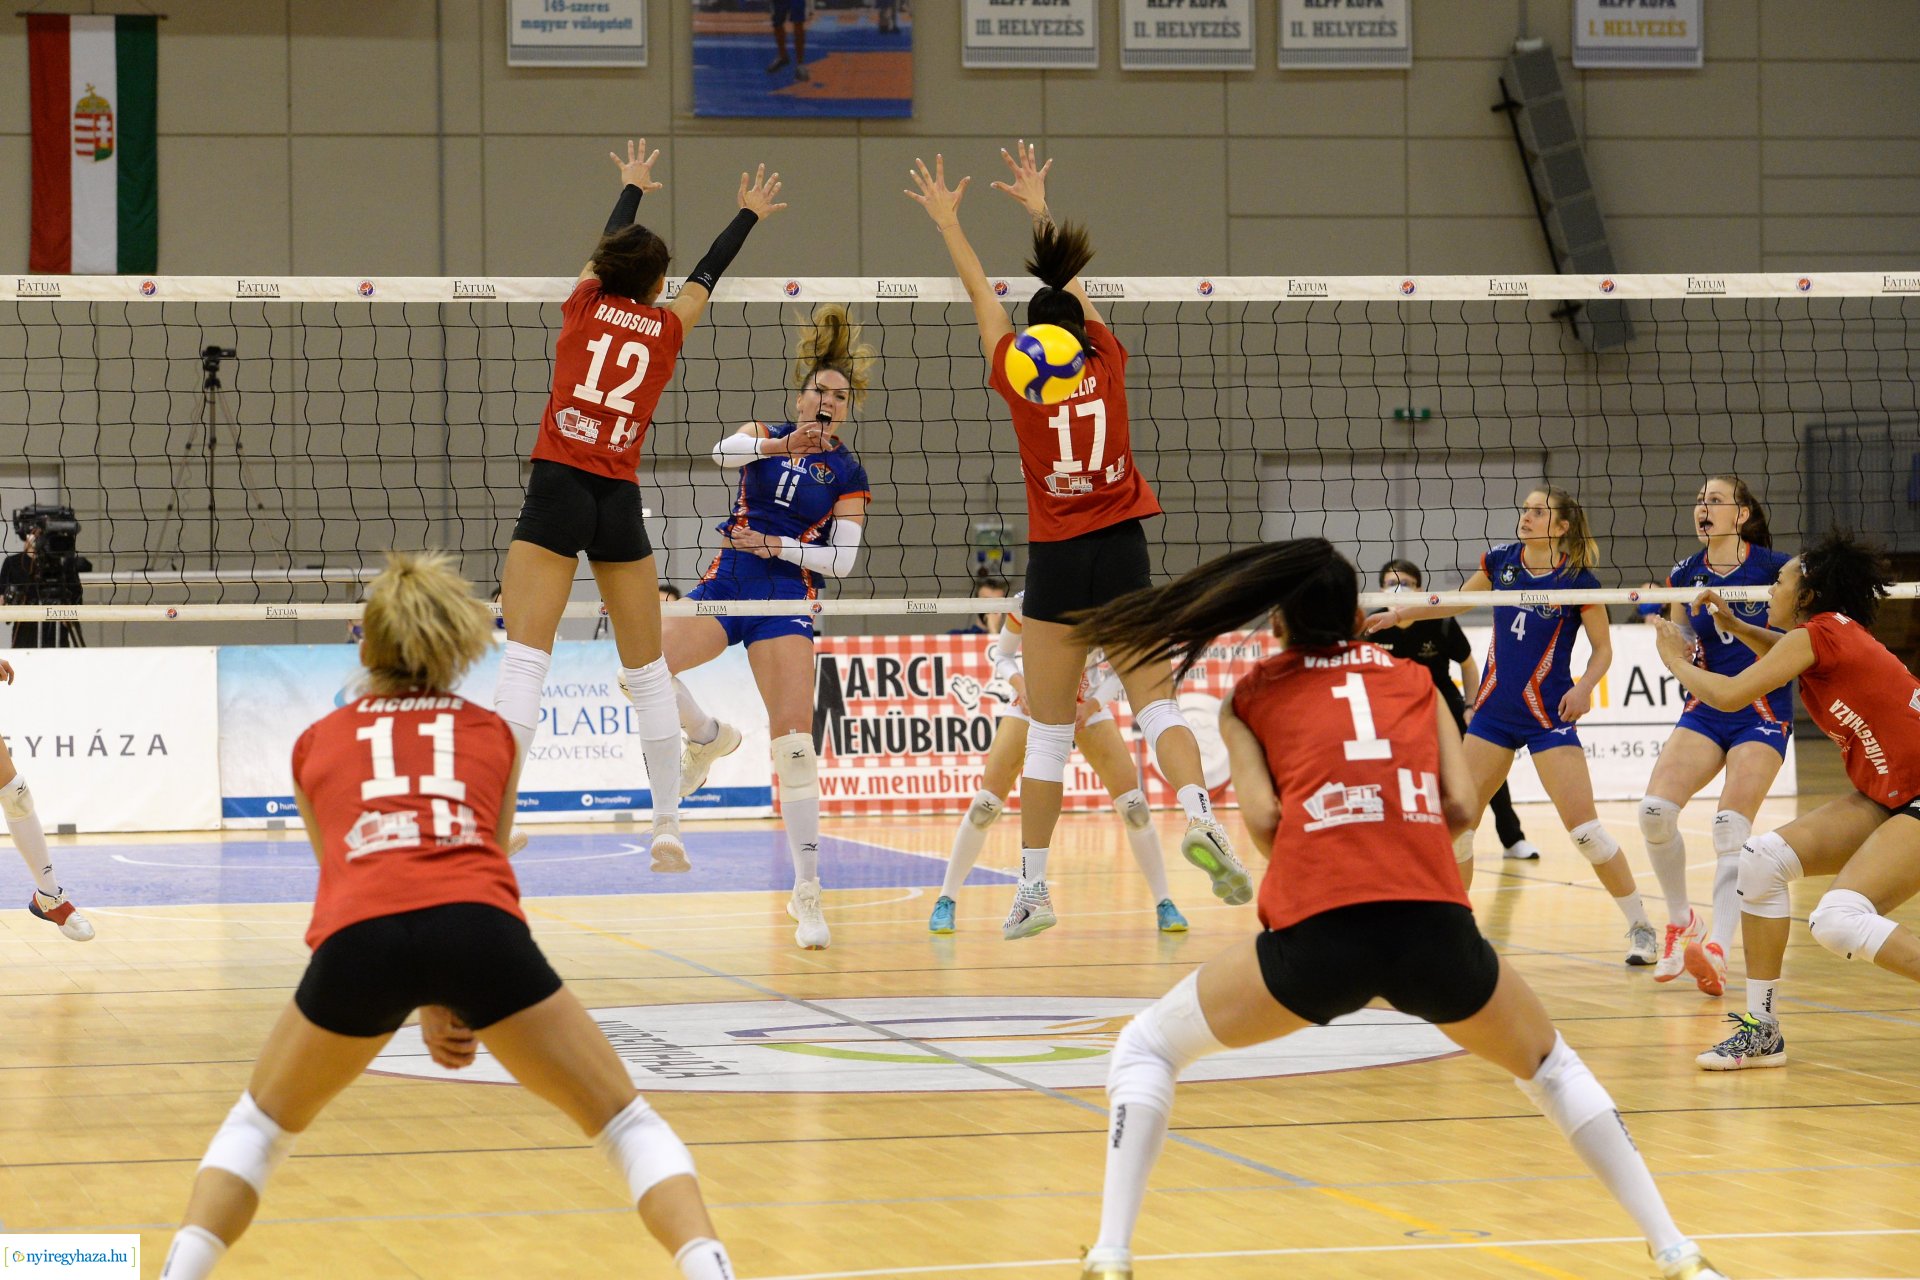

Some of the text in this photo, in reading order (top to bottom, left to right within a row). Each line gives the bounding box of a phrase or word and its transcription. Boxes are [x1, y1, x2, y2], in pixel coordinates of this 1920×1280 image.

[521, 19, 567, 32] magyar
[998, 14, 1085, 36] HELYEZÉS
[1156, 16, 1241, 38] HELYEZÉS
[1313, 15, 1398, 37] HELYEZÉS
[1603, 16, 1687, 37] HELYEZÉS
[594, 303, 662, 337] RADOSOVA
[572, 332, 650, 414] 12
[1049, 398, 1107, 474] 17
[774, 470, 800, 508] 11
[1510, 611, 1527, 641] 4
[1331, 671, 1392, 761] 1
[355, 713, 466, 802] 11
[529, 741, 624, 760] SZÖVETSÉG
